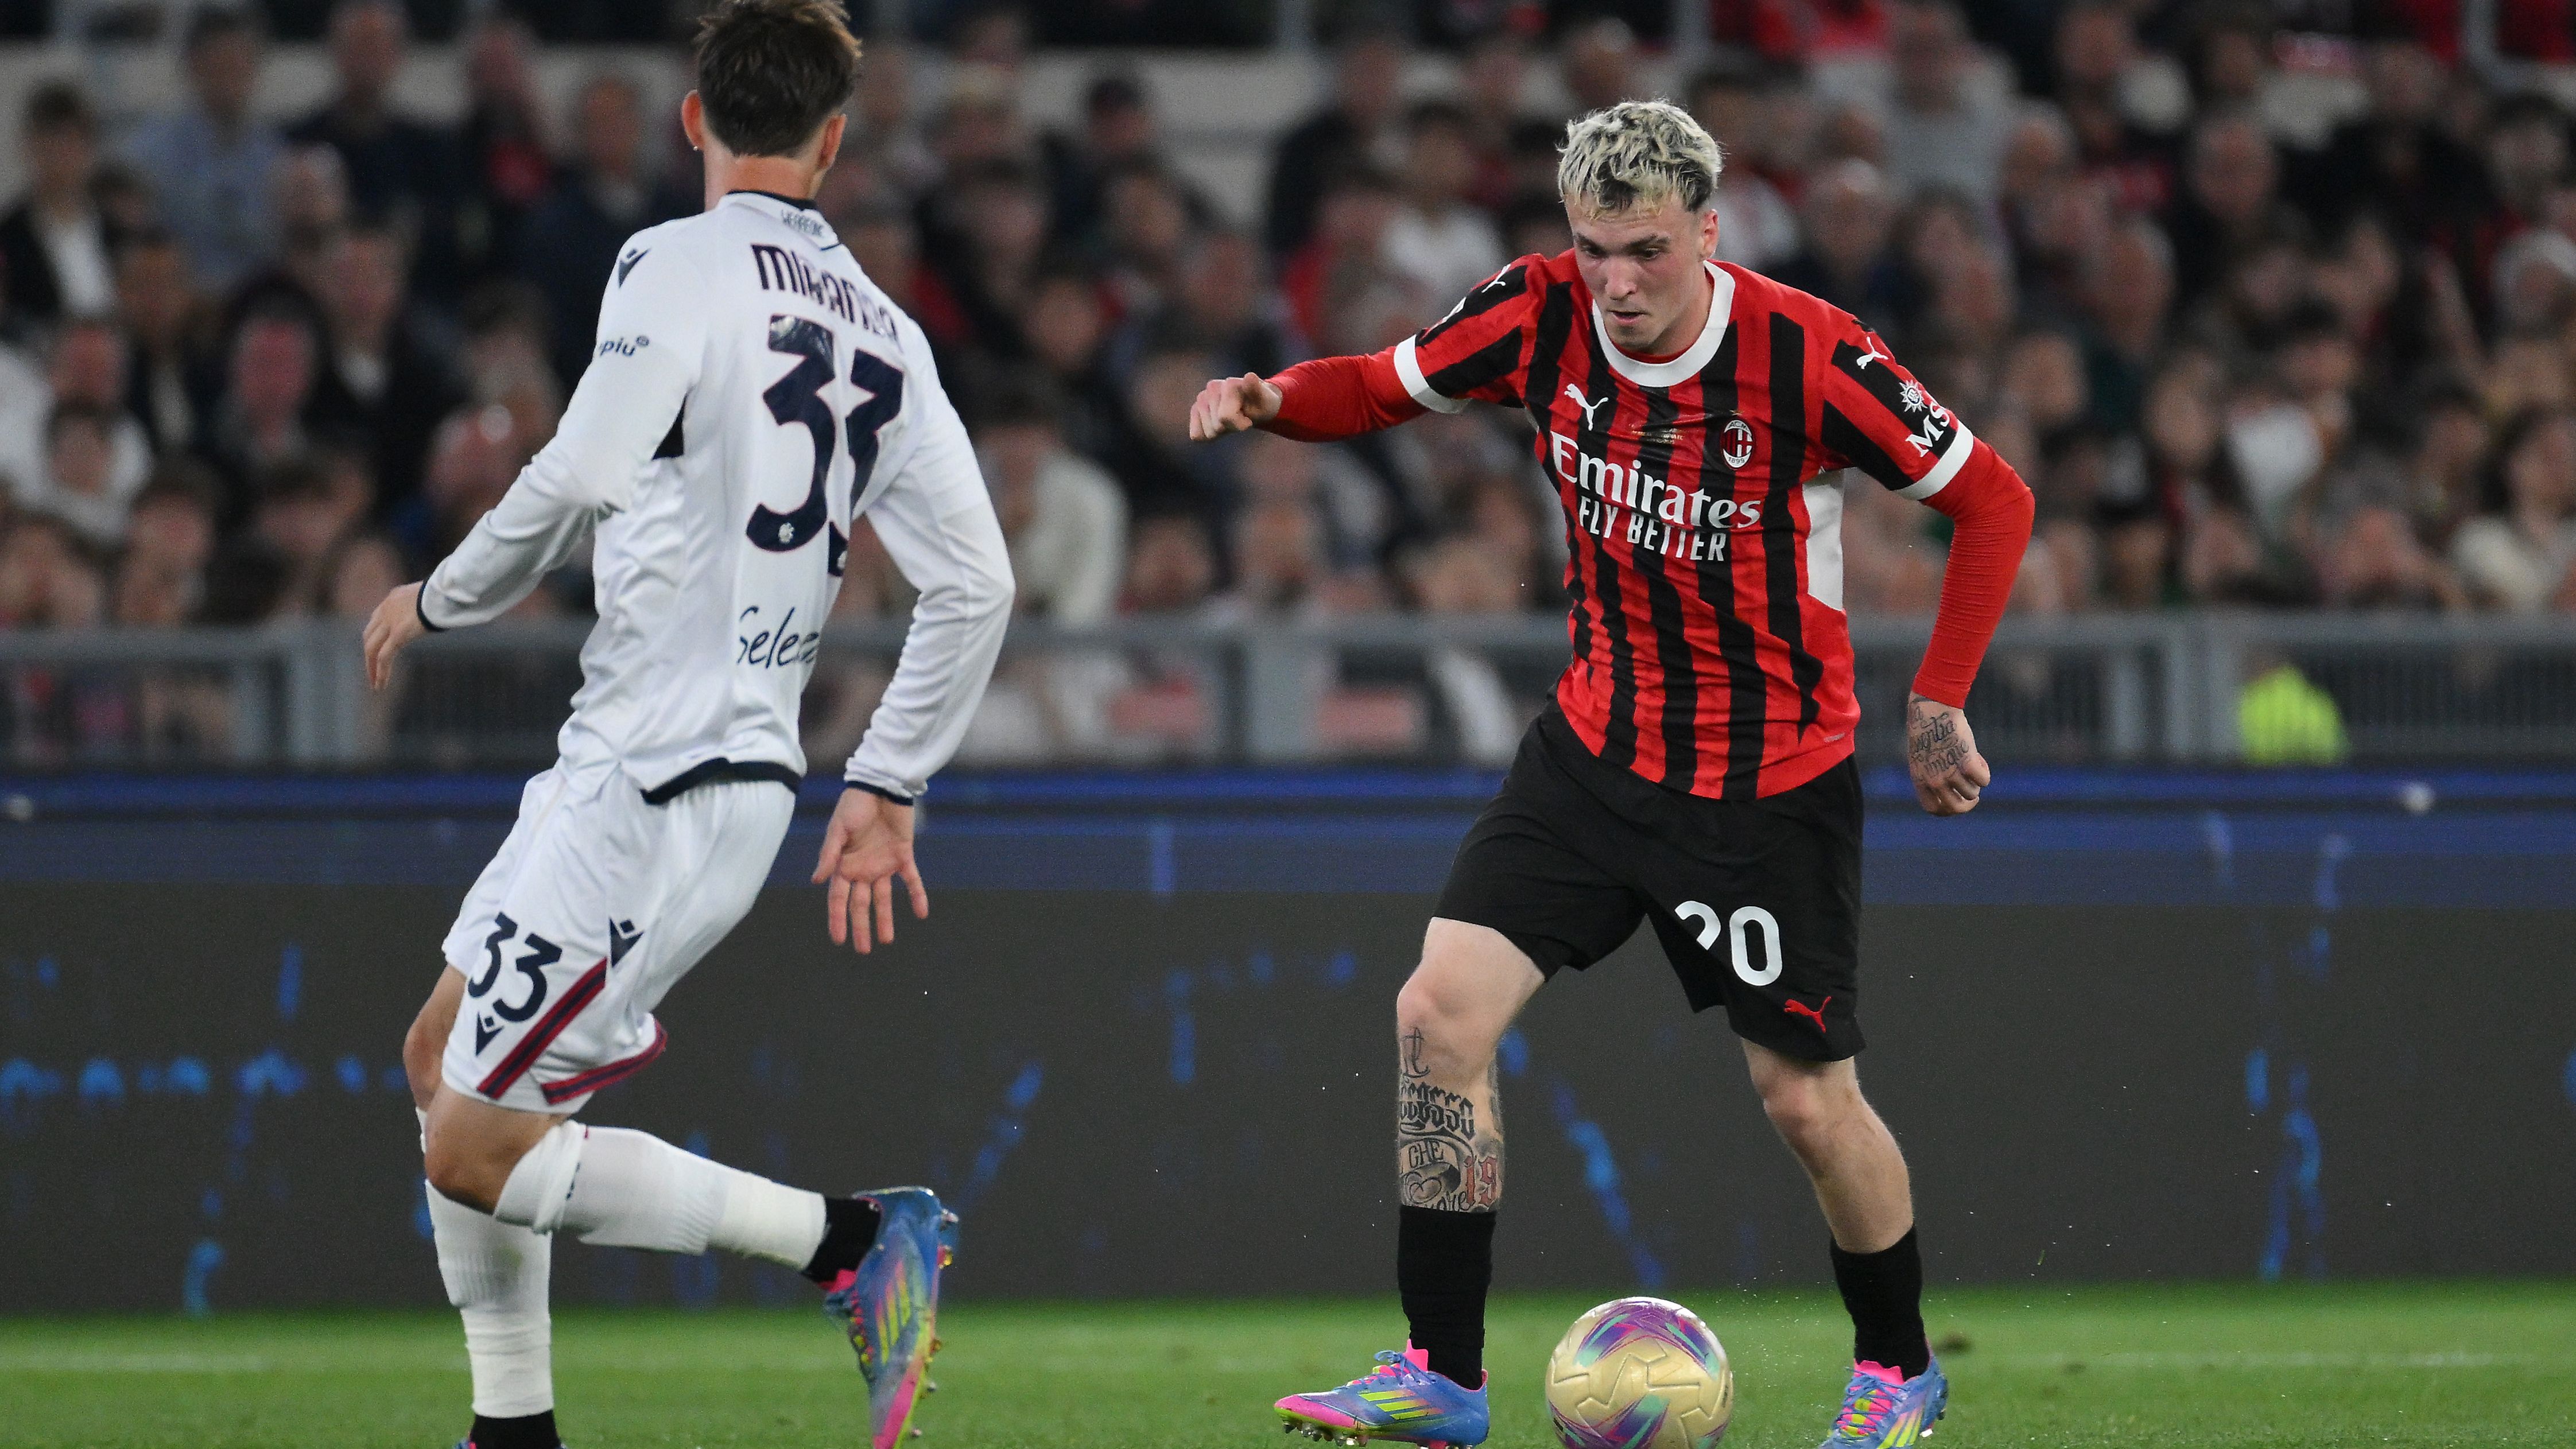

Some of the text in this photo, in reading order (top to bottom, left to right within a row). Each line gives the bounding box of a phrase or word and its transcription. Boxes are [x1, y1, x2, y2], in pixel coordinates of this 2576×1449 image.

[1550, 430, 1762, 529] Emirates
[1578, 495, 1727, 562] FLY BETTER
[468, 911, 562, 1023] 33
